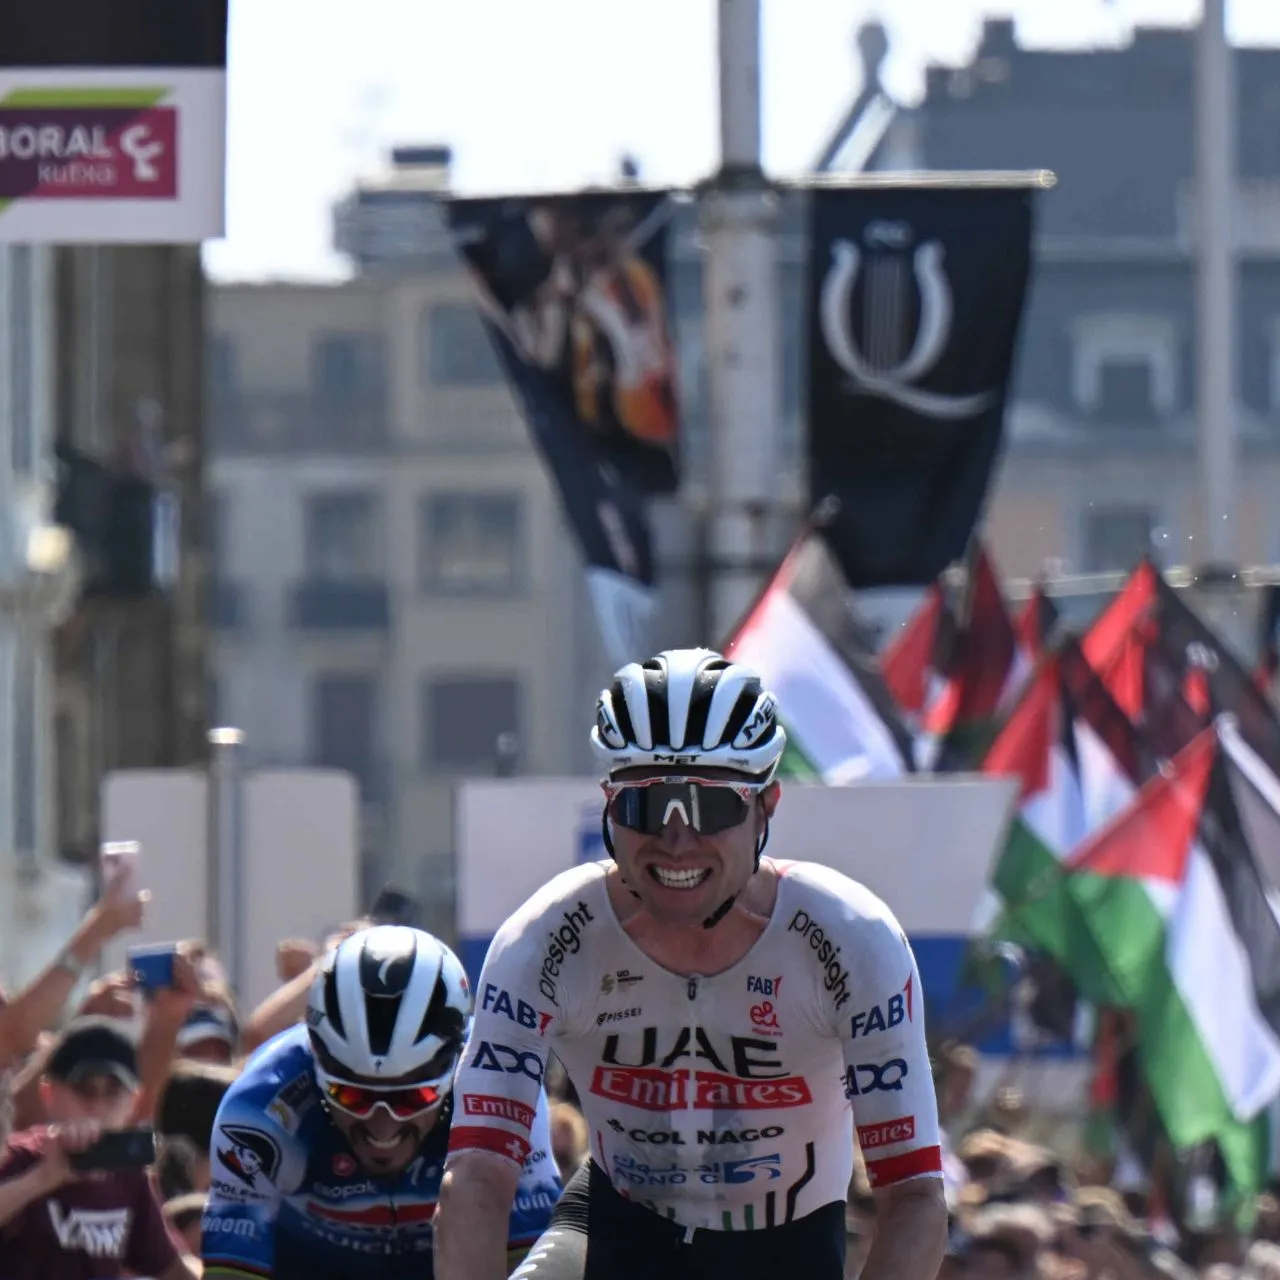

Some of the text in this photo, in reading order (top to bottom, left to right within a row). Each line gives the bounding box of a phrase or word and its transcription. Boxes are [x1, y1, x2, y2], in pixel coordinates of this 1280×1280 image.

[653, 754, 701, 764] MET
[539, 900, 595, 1008] presight
[787, 909, 851, 1012] presight
[601, 1026, 791, 1080] UAE
[600, 1068, 806, 1106] Emirates
